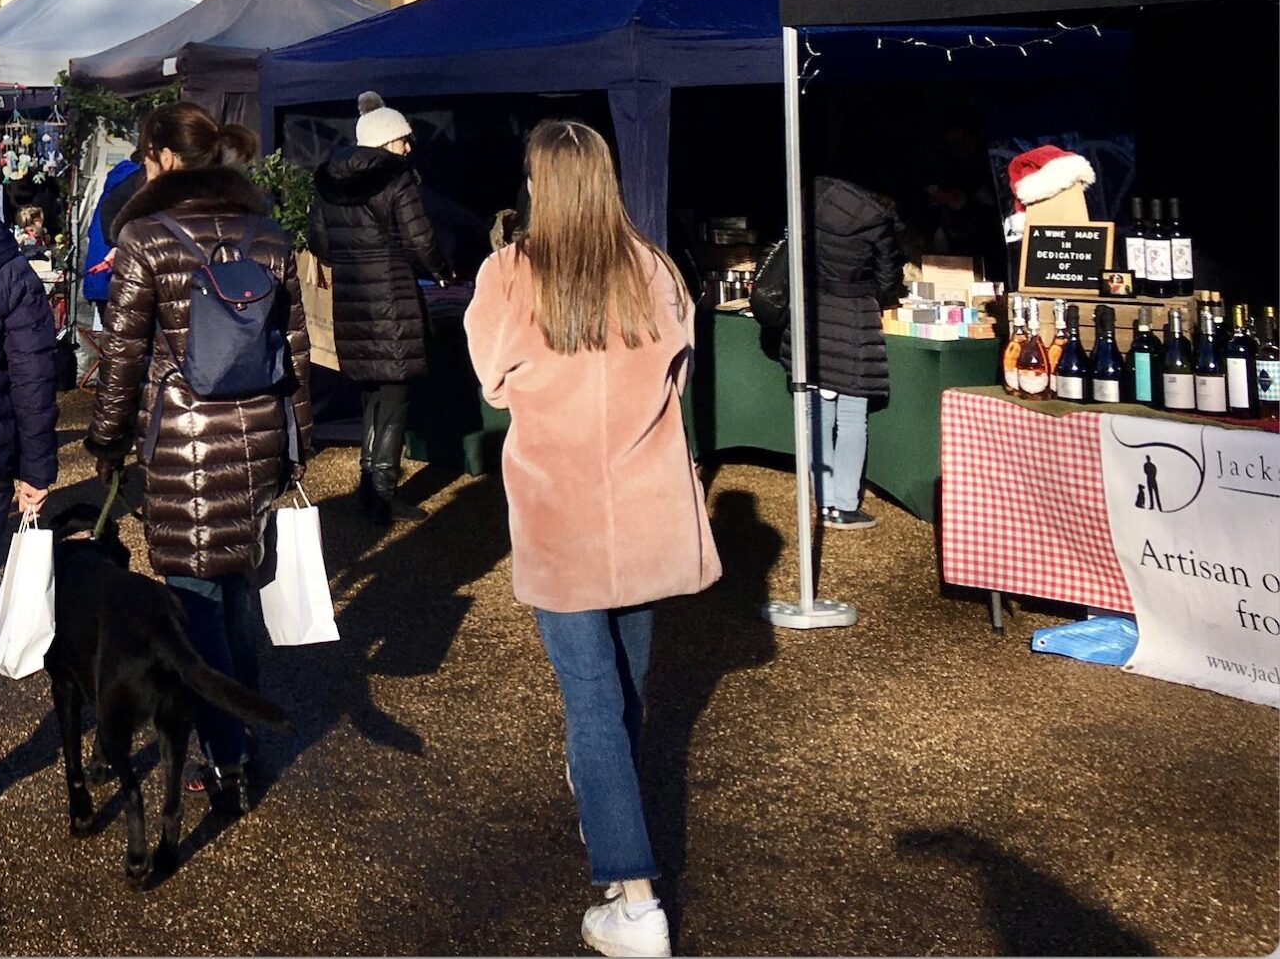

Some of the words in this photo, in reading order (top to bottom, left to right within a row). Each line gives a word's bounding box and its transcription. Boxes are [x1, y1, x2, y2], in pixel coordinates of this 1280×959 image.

[1045, 230, 1066, 238] WINE
[1075, 231, 1100, 239] MADE
[1036, 251, 1092, 260] DEDICATION
[1045, 273, 1083, 281] JACKSON
[1216, 449, 1280, 482] Jack
[1140, 538, 1252, 589] Artisan
